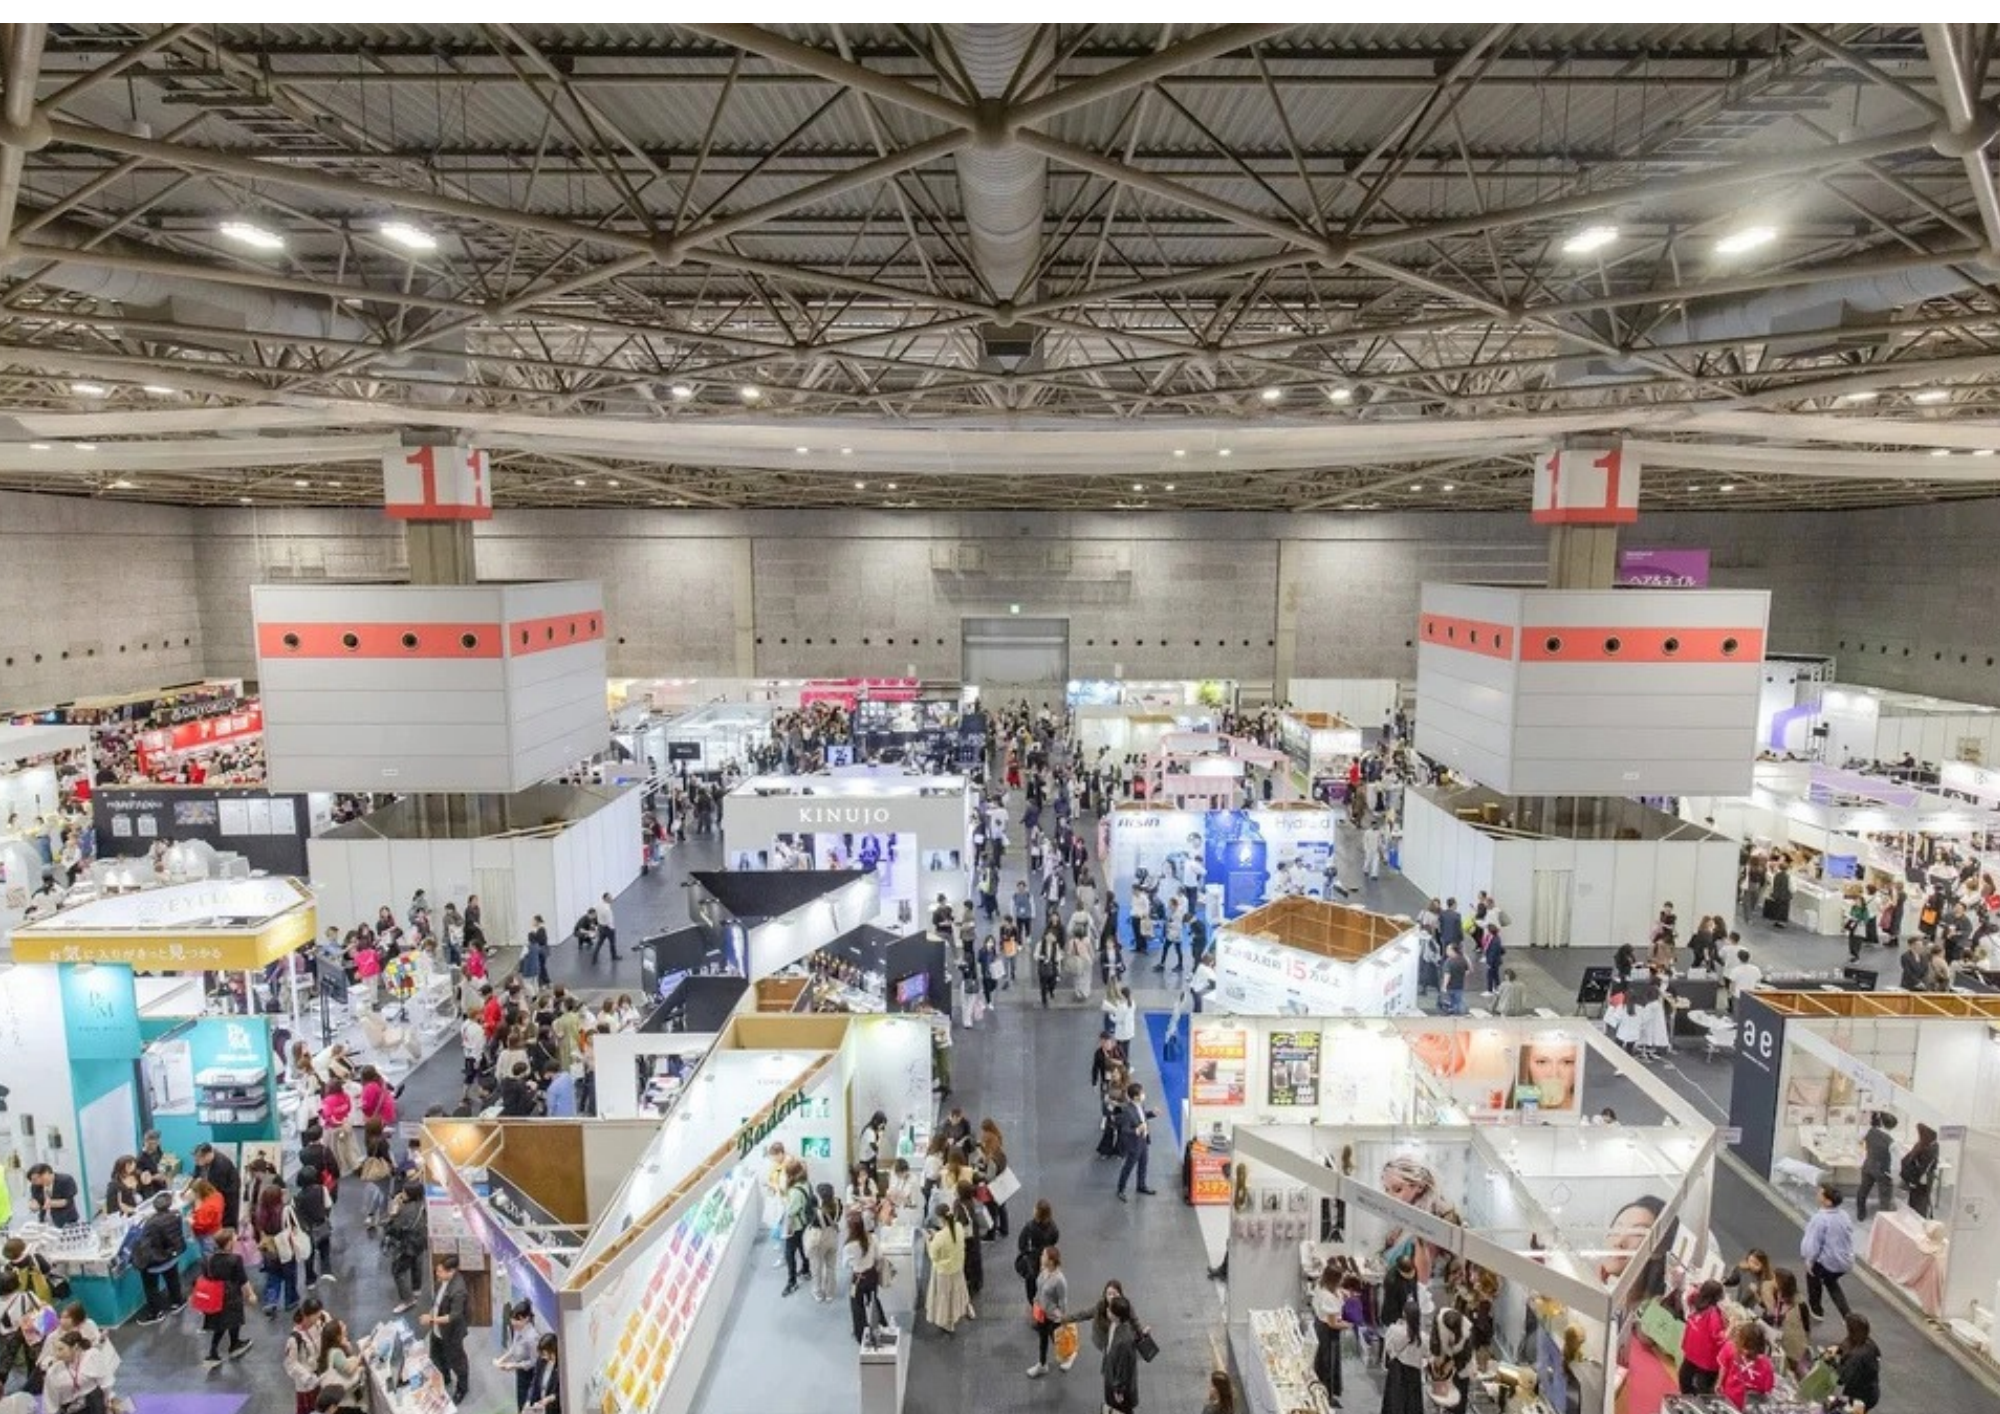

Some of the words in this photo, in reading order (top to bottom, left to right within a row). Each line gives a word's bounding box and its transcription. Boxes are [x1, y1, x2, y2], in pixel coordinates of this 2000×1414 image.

[406, 445, 437, 506] 1
[1593, 449, 1622, 508] 1
[800, 808, 890, 825] KINUJO
